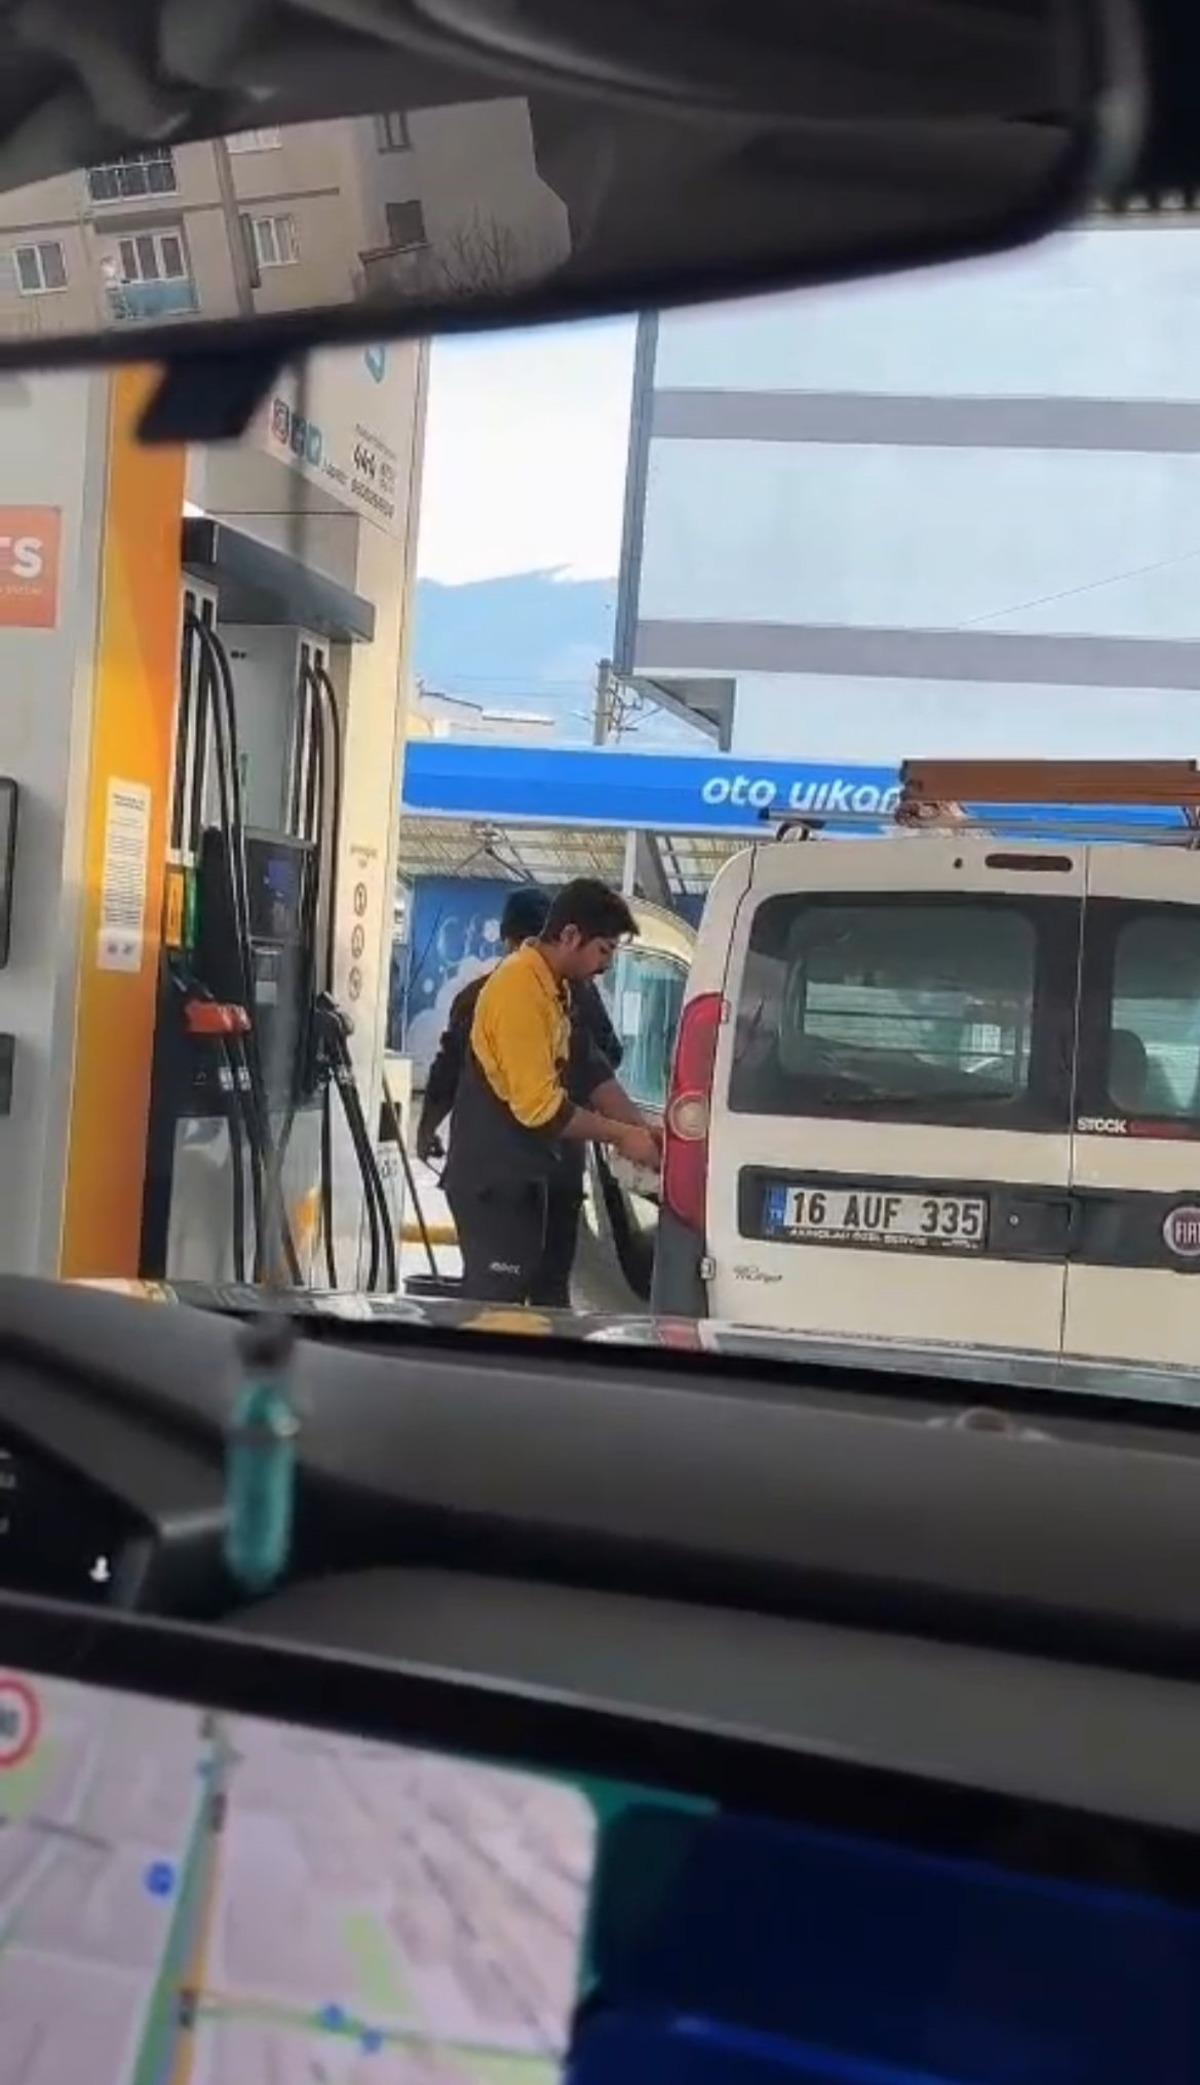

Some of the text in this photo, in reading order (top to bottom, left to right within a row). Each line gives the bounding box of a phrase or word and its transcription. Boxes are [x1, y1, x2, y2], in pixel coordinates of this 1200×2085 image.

[0, 536, 44, 579] S
[702, 775, 777, 807] oto
[1077, 1117, 1127, 1133] STOCK
[793, 1191, 981, 1236] 16 AUF 335
[1175, 1220, 1200, 1244] FIA
